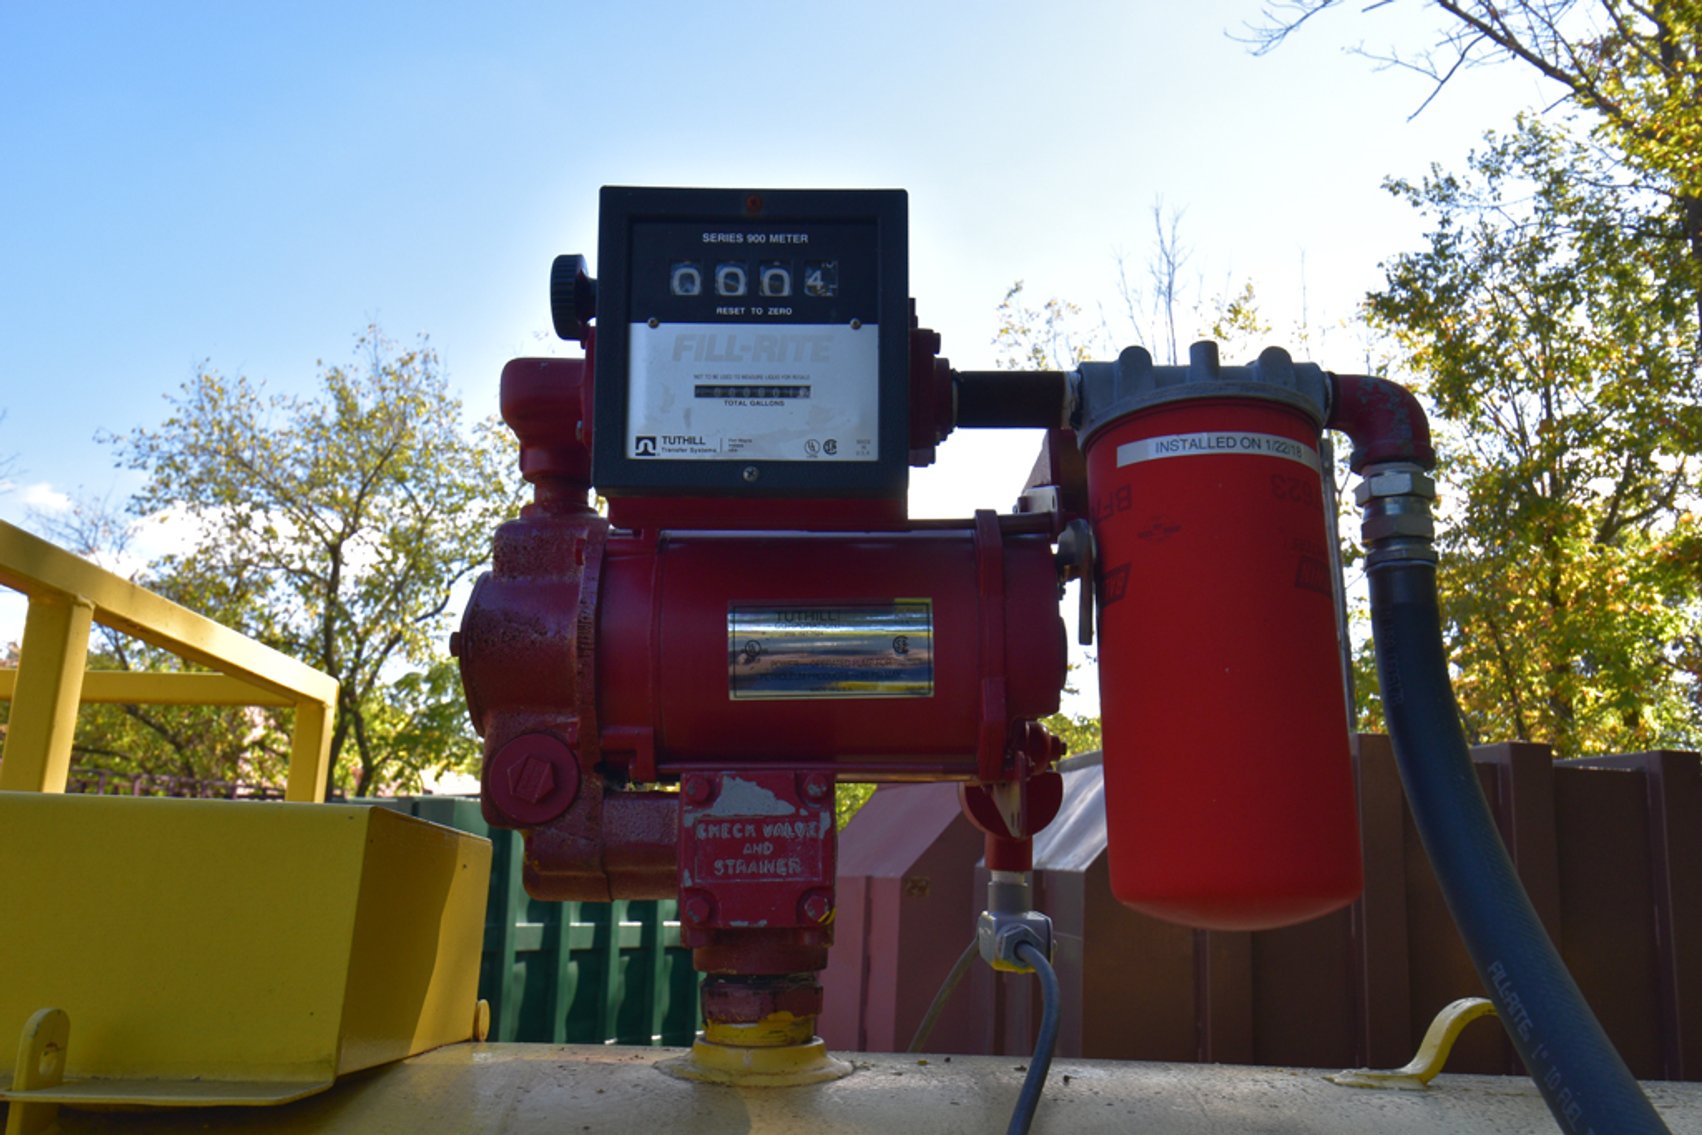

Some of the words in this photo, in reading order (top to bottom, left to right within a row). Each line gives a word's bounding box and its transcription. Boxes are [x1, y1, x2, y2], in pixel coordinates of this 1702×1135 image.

[702, 233, 744, 243] SERIES
[747, 234, 766, 243] 900
[769, 234, 809, 244] METER
[716, 307, 745, 315] RESET
[751, 307, 763, 315] TO
[768, 307, 793, 315] ZERO
[671, 333, 834, 362] FILL-RITE
[661, 435, 706, 446] TUTHILL
[1155, 436, 1237, 454] INSTALLED
[1240, 437, 1261, 450] ON
[690, 447, 717, 455] Systems
[696, 823, 756, 839] CHECK
[763, 822, 818, 838] VALVE
[743, 842, 774, 855] AND
[714, 858, 801, 875] STRAINER
